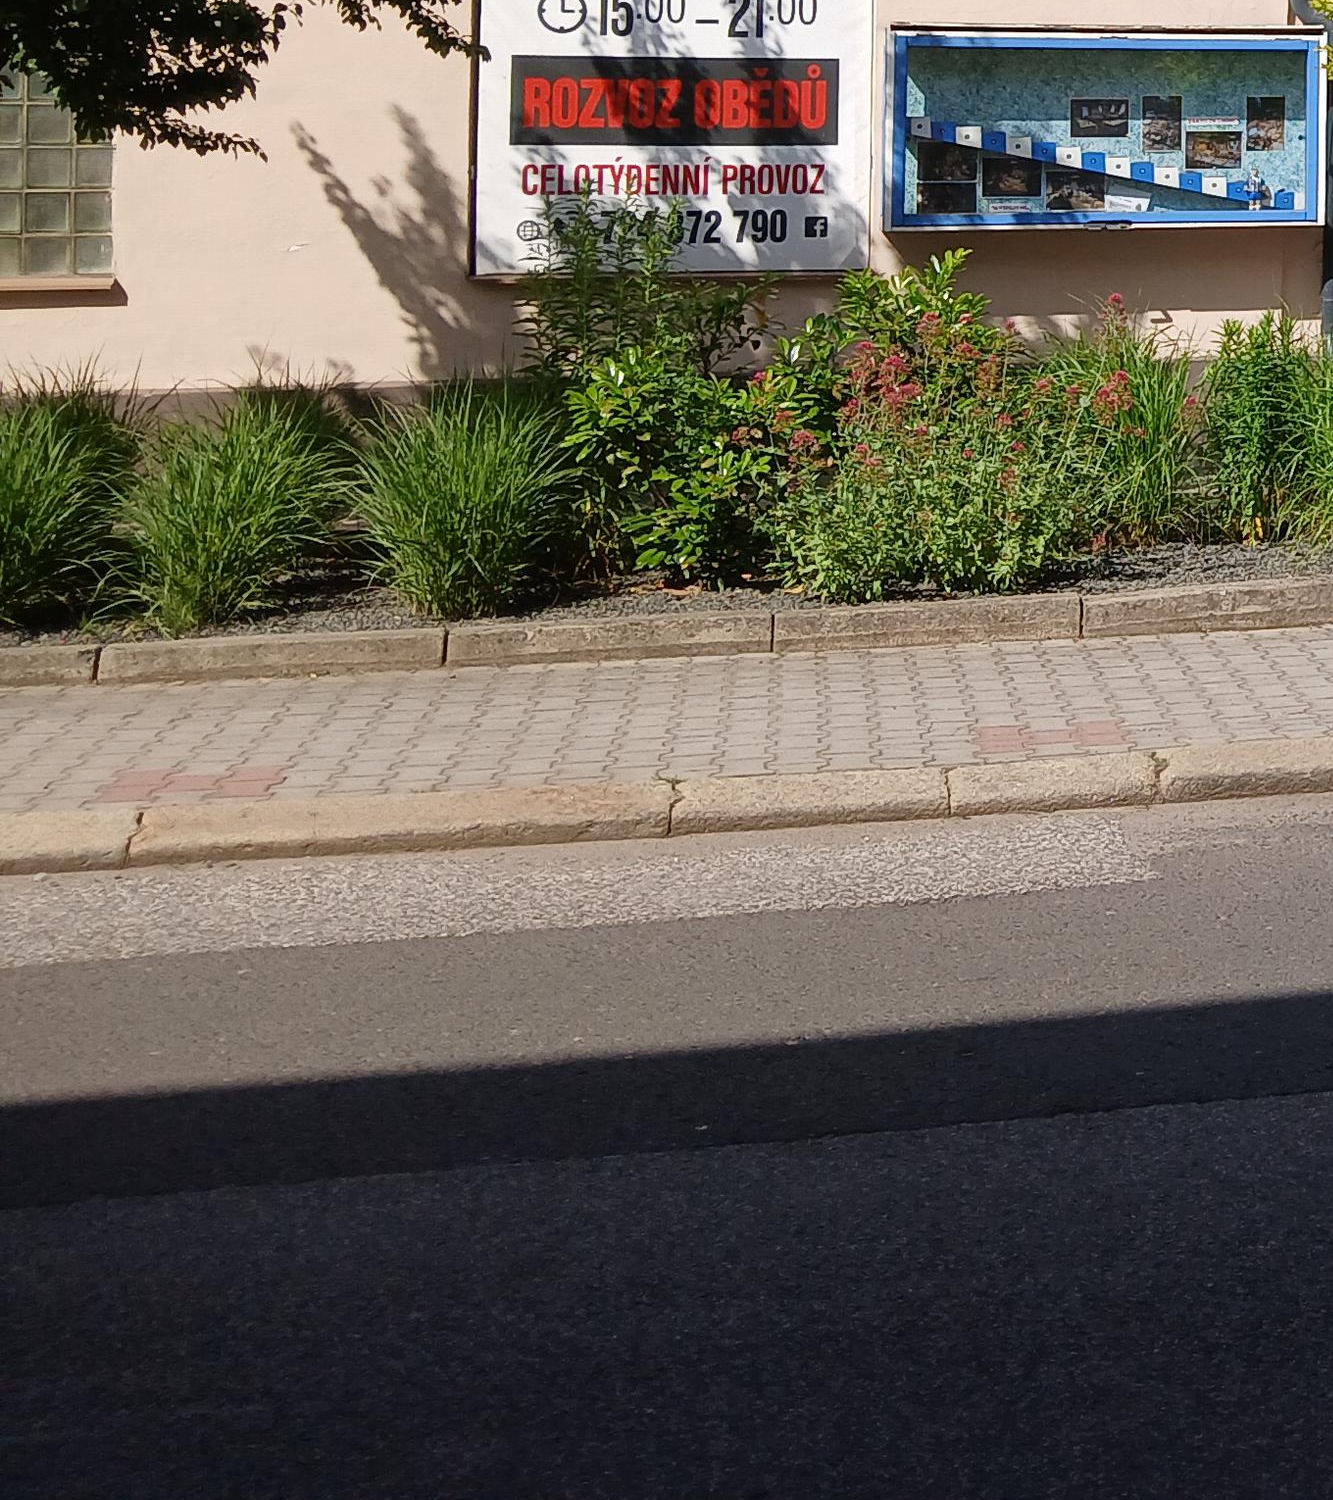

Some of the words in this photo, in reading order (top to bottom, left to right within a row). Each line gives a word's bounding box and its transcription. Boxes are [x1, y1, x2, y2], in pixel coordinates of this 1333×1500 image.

[522, 77, 682, 129] ROZVOZ
[694, 63, 828, 130] OBĚDŮ
[521, 157, 713, 196] CELOTÝDENNÍ
[721, 164, 826, 195] PROVOZ
[732, 210, 788, 244] 790
